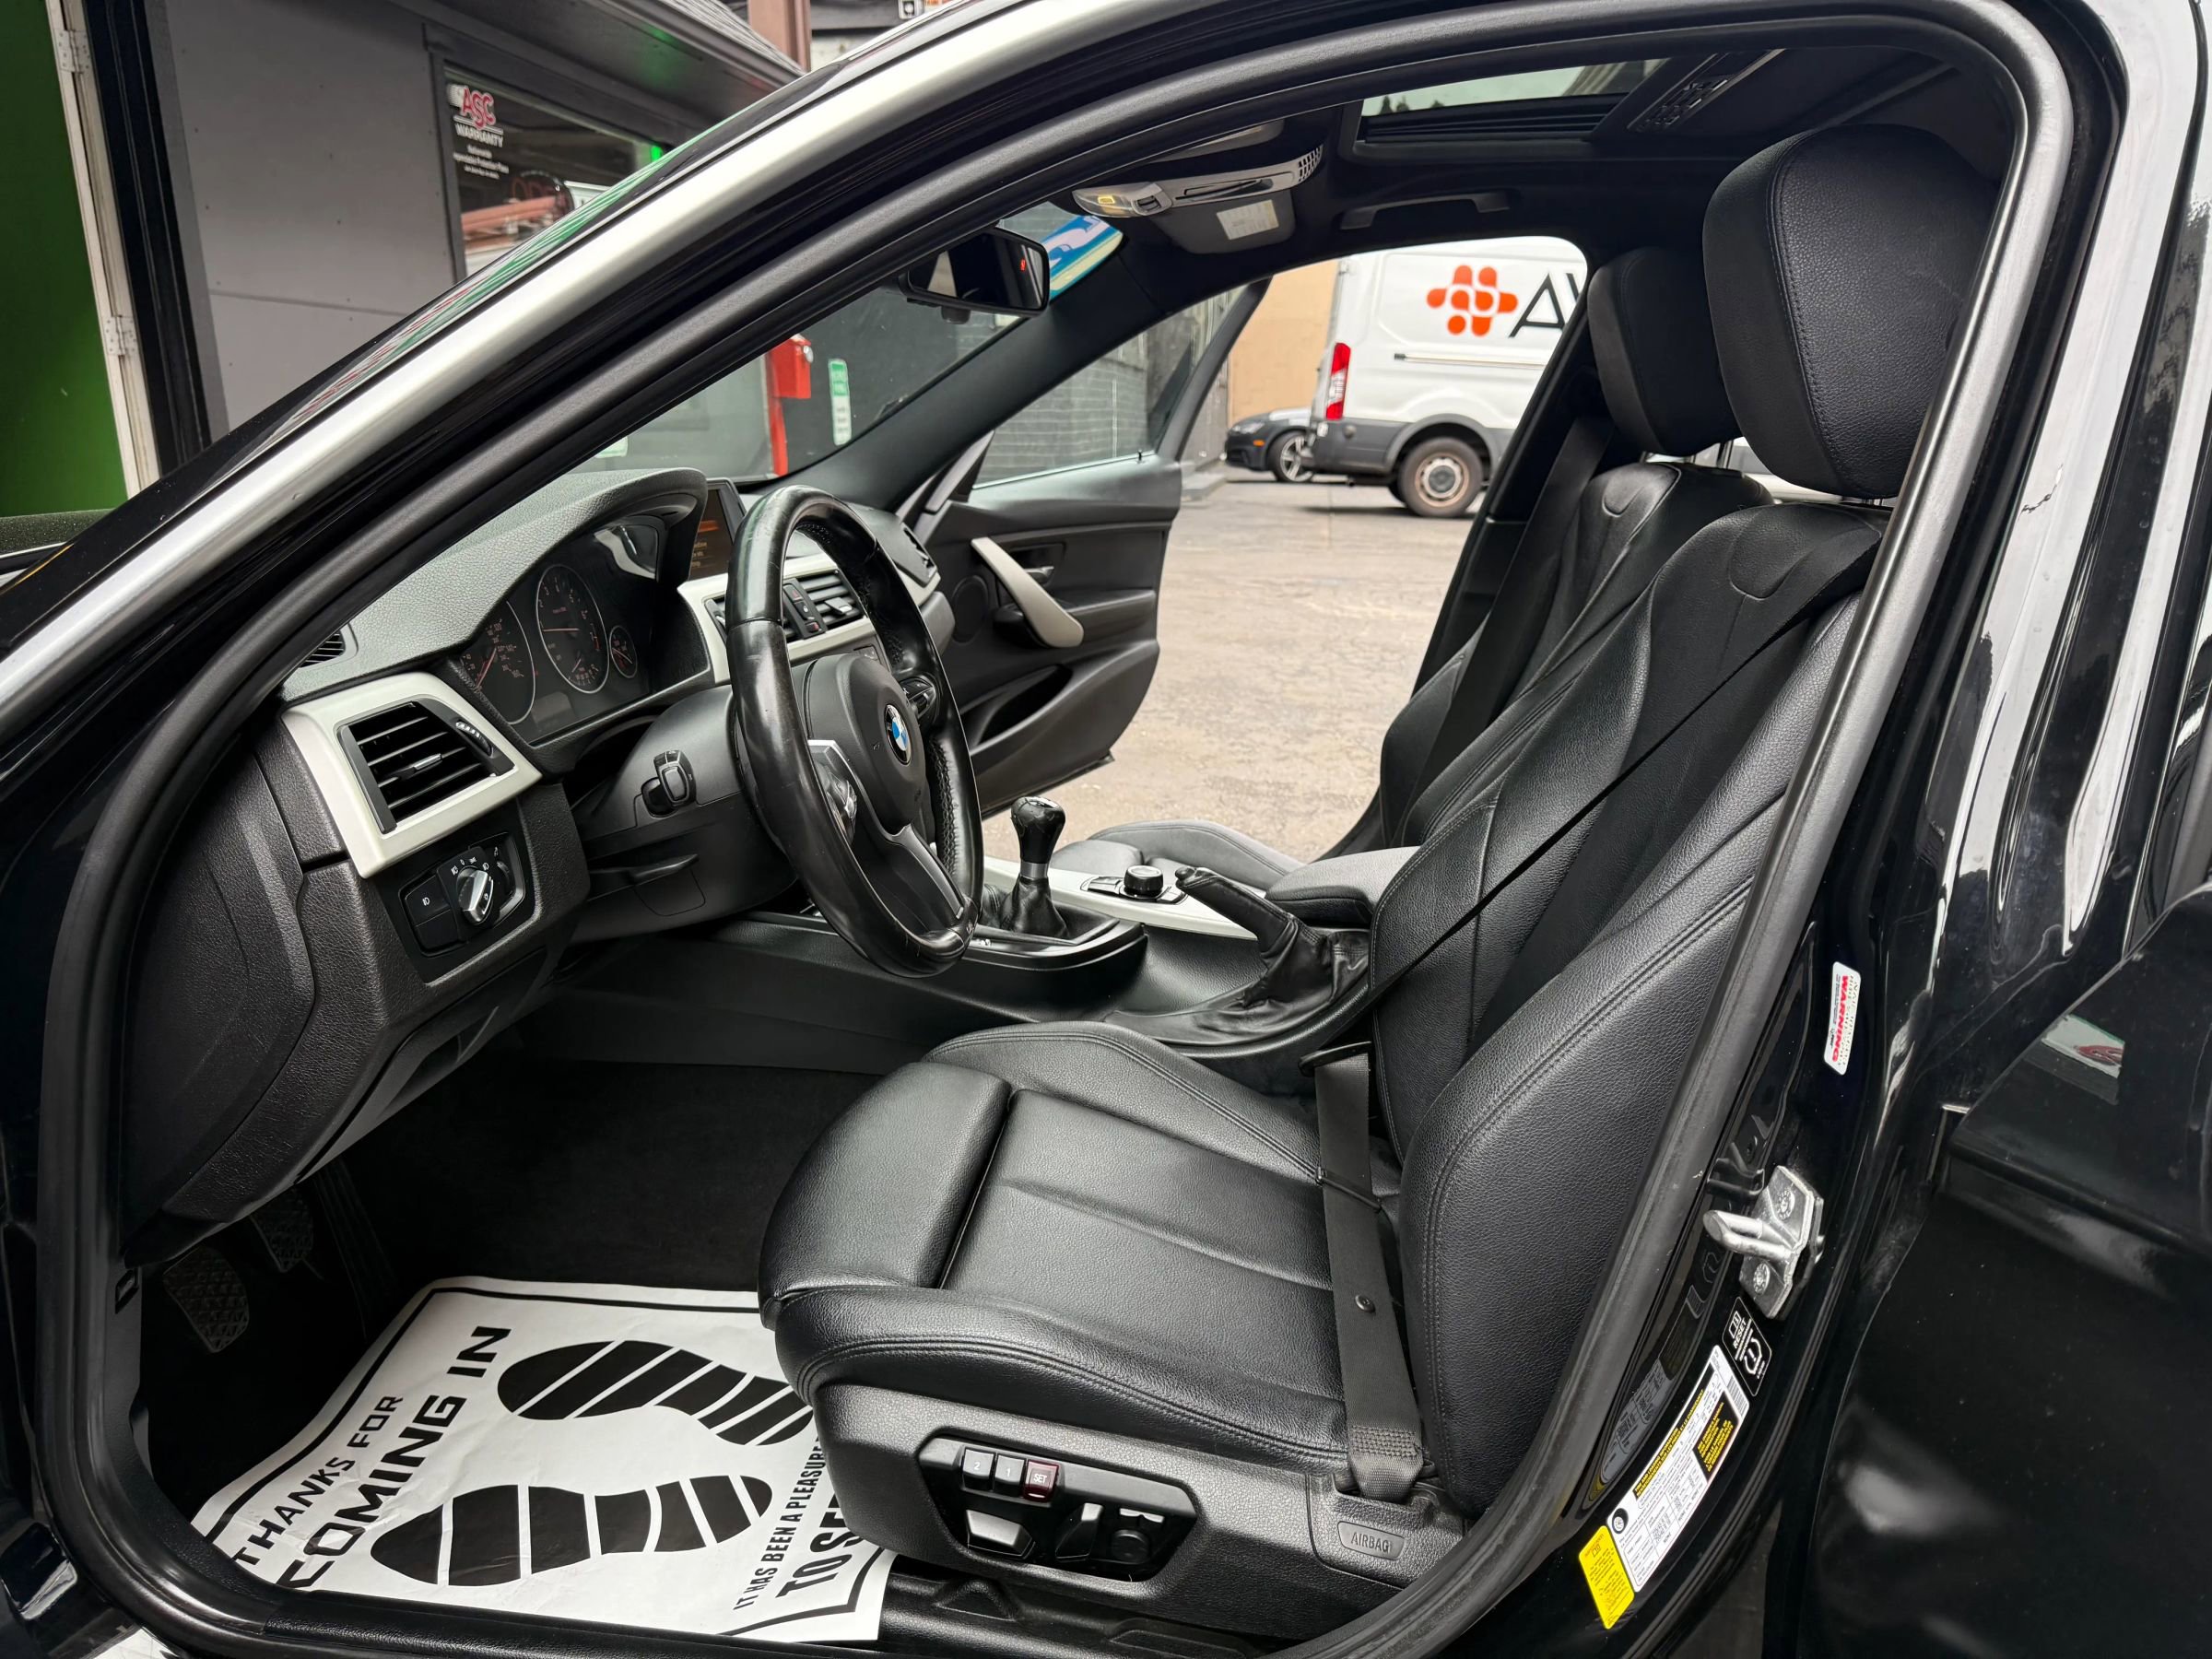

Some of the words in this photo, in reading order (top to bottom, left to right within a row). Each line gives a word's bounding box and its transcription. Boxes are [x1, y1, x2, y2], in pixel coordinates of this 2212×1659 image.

[461, 87, 496, 129] ASC
[454, 123, 504, 147] WARRANTY
[1832, 975, 1849, 1062] WARNING
[1733, 1317, 1747, 1349] RESET
[276, 1394, 467, 1589] COMING
[446, 1325, 512, 1378] IN
[973, 1461, 981, 1470] 2
[1006, 1467, 1011, 1477] 1
[1032, 1473, 1048, 1484] SET
[232, 1456, 356, 1566] THANKS
[347, 1395, 404, 1448] FOR
[780, 1512, 804, 1524] A
[810, 1493, 864, 1553] SE
[760, 1525, 797, 1562] BEEN
[1351, 1532, 1390, 1554] AIRBAG
[743, 1568, 779, 1595] HAS
[774, 1554, 853, 1598] TO
[733, 1594, 759, 1611] IT
